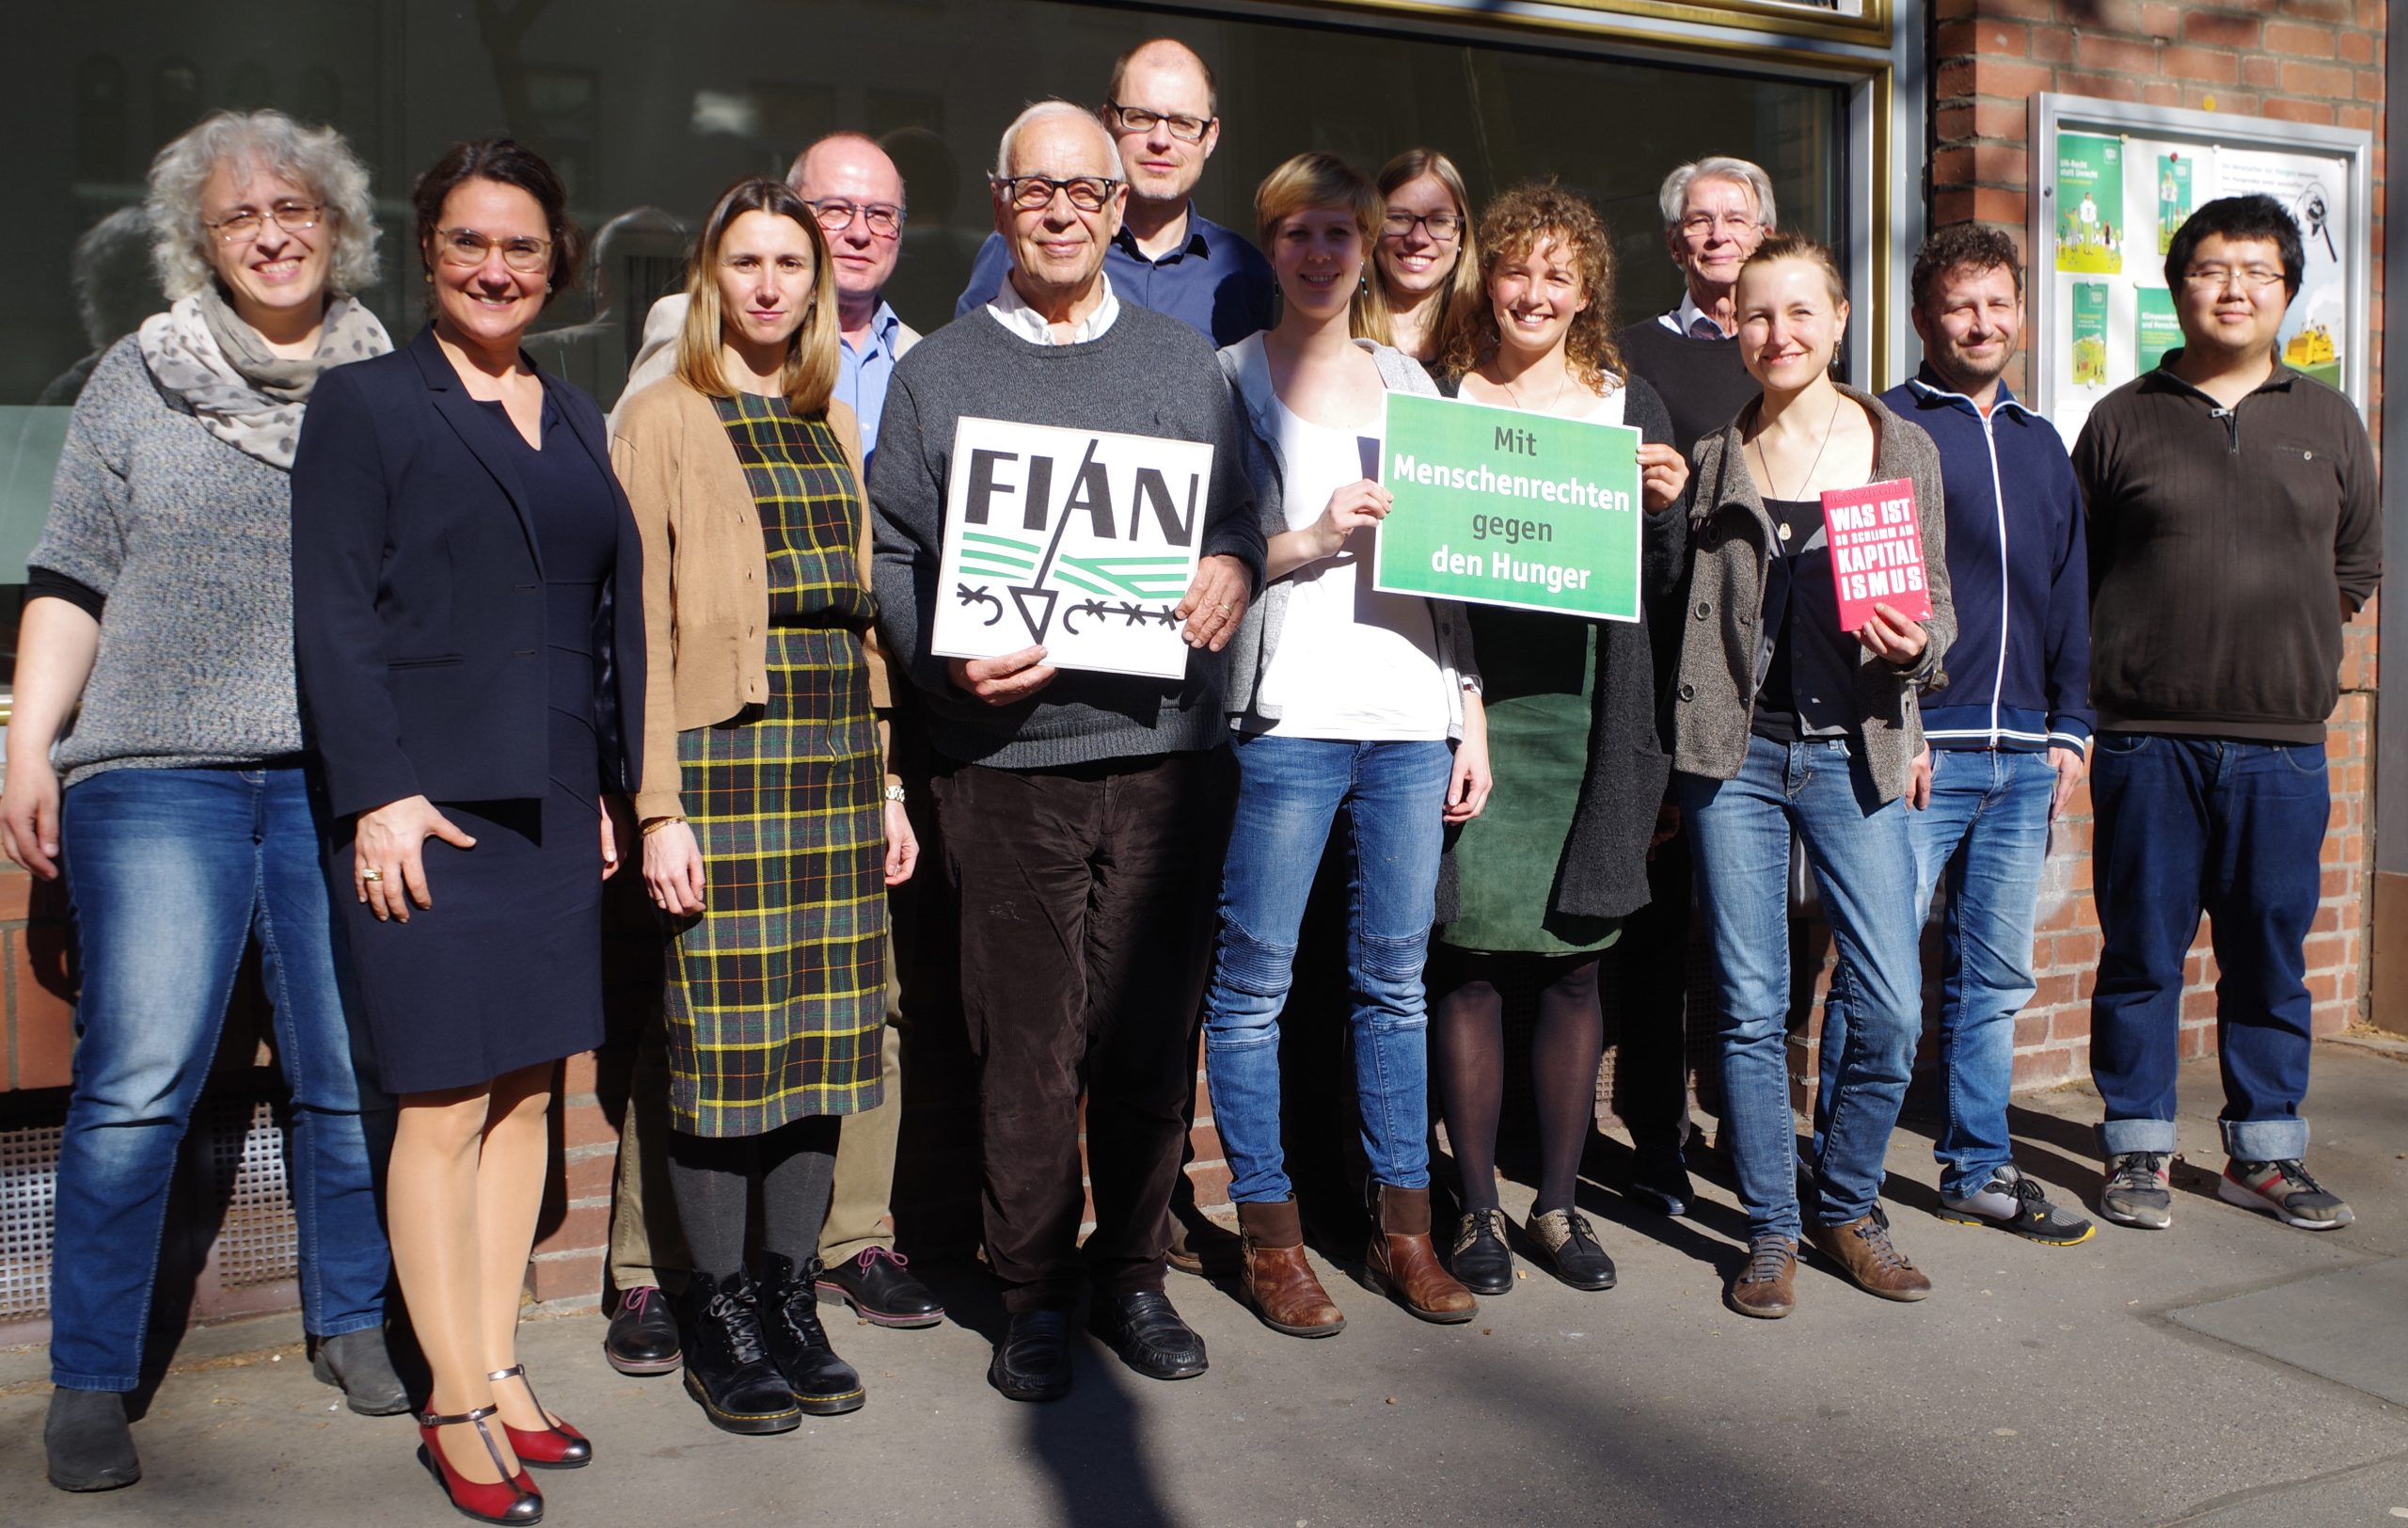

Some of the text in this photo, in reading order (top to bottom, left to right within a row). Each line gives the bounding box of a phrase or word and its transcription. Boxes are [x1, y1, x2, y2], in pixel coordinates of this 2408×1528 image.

[1494, 426, 1537, 456] Mit
[964, 438, 1199, 547] FIAN
[1393, 453, 1630, 512] Menschenrechten
[1829, 484, 1909, 504] JEAN ZIEGLER
[1472, 514, 1553, 544] gegen
[1830, 498, 1910, 533] WAS IST
[1834, 524, 1915, 547] SO SCHLIMM AM
[1432, 545, 1592, 593] den Hunger
[1836, 538, 1920, 574] KAPITAL
[1841, 565, 1923, 601] ISMUS
